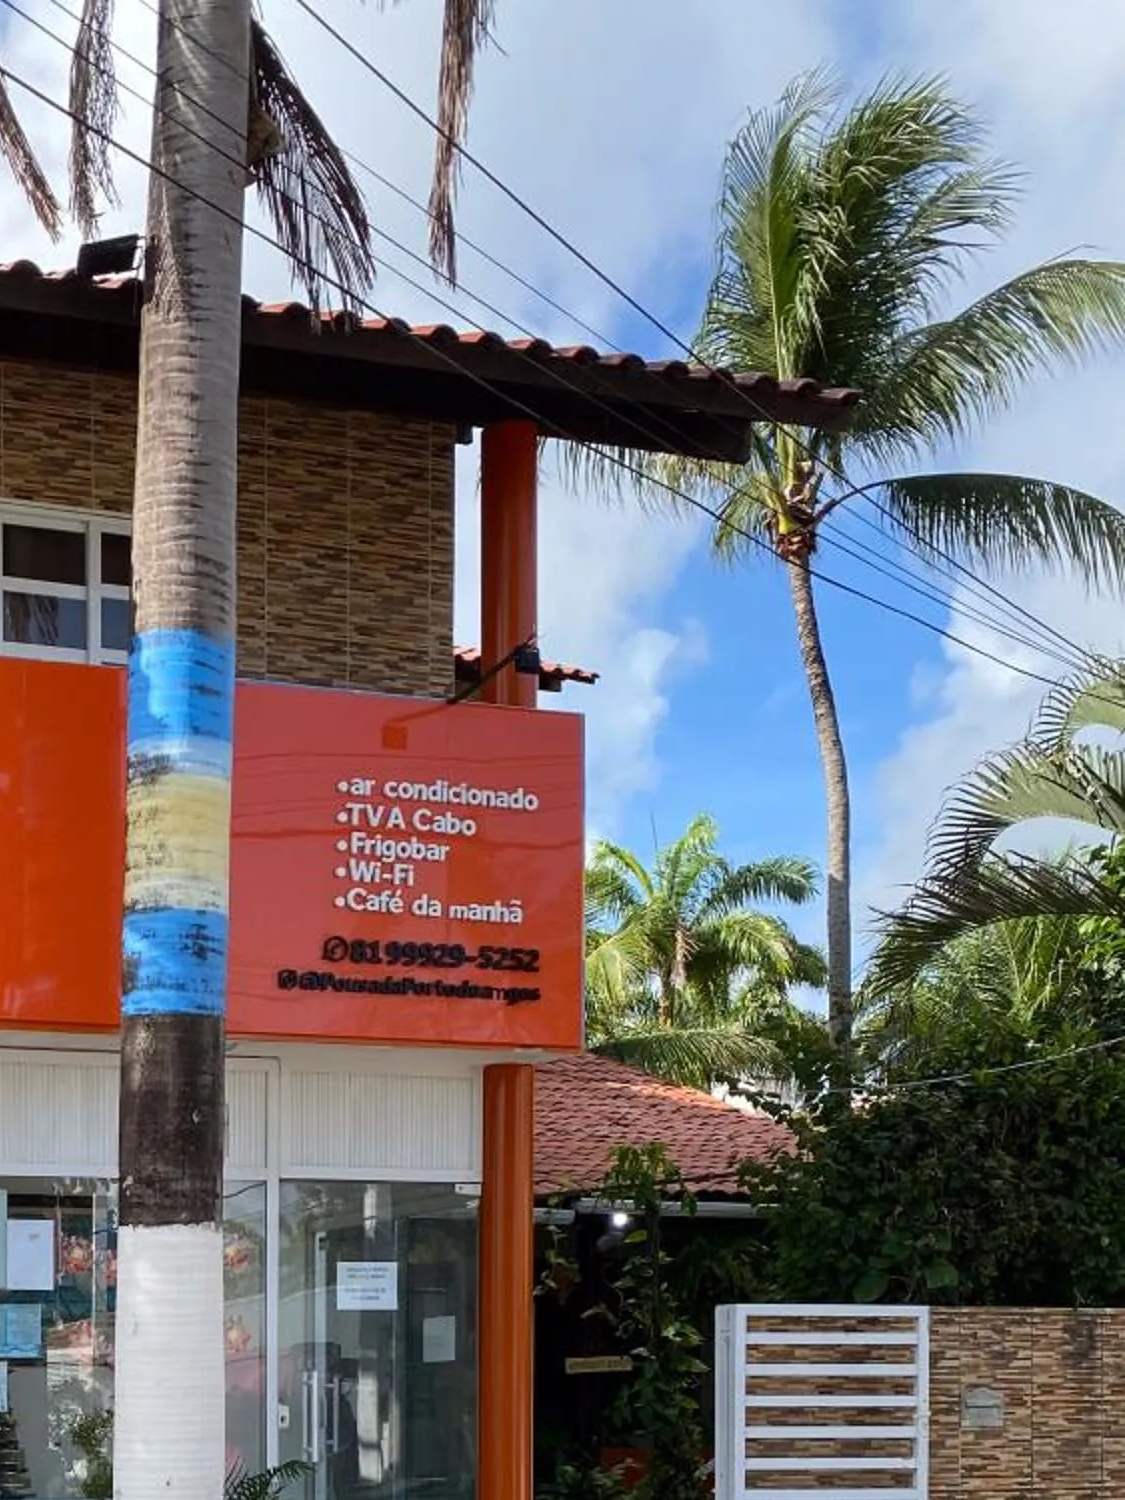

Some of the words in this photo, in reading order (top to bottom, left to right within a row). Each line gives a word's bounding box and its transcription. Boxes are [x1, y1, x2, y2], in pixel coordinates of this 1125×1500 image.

[350, 777, 376, 796] ar
[383, 779, 540, 811] condicionado
[412, 807, 477, 836] Cabo
[350, 831, 450, 863] Frigobar
[349, 858, 415, 886] Wi-Fi
[347, 886, 404, 914] Café
[411, 893, 443, 917] da
[449, 899, 524, 924] manhã
